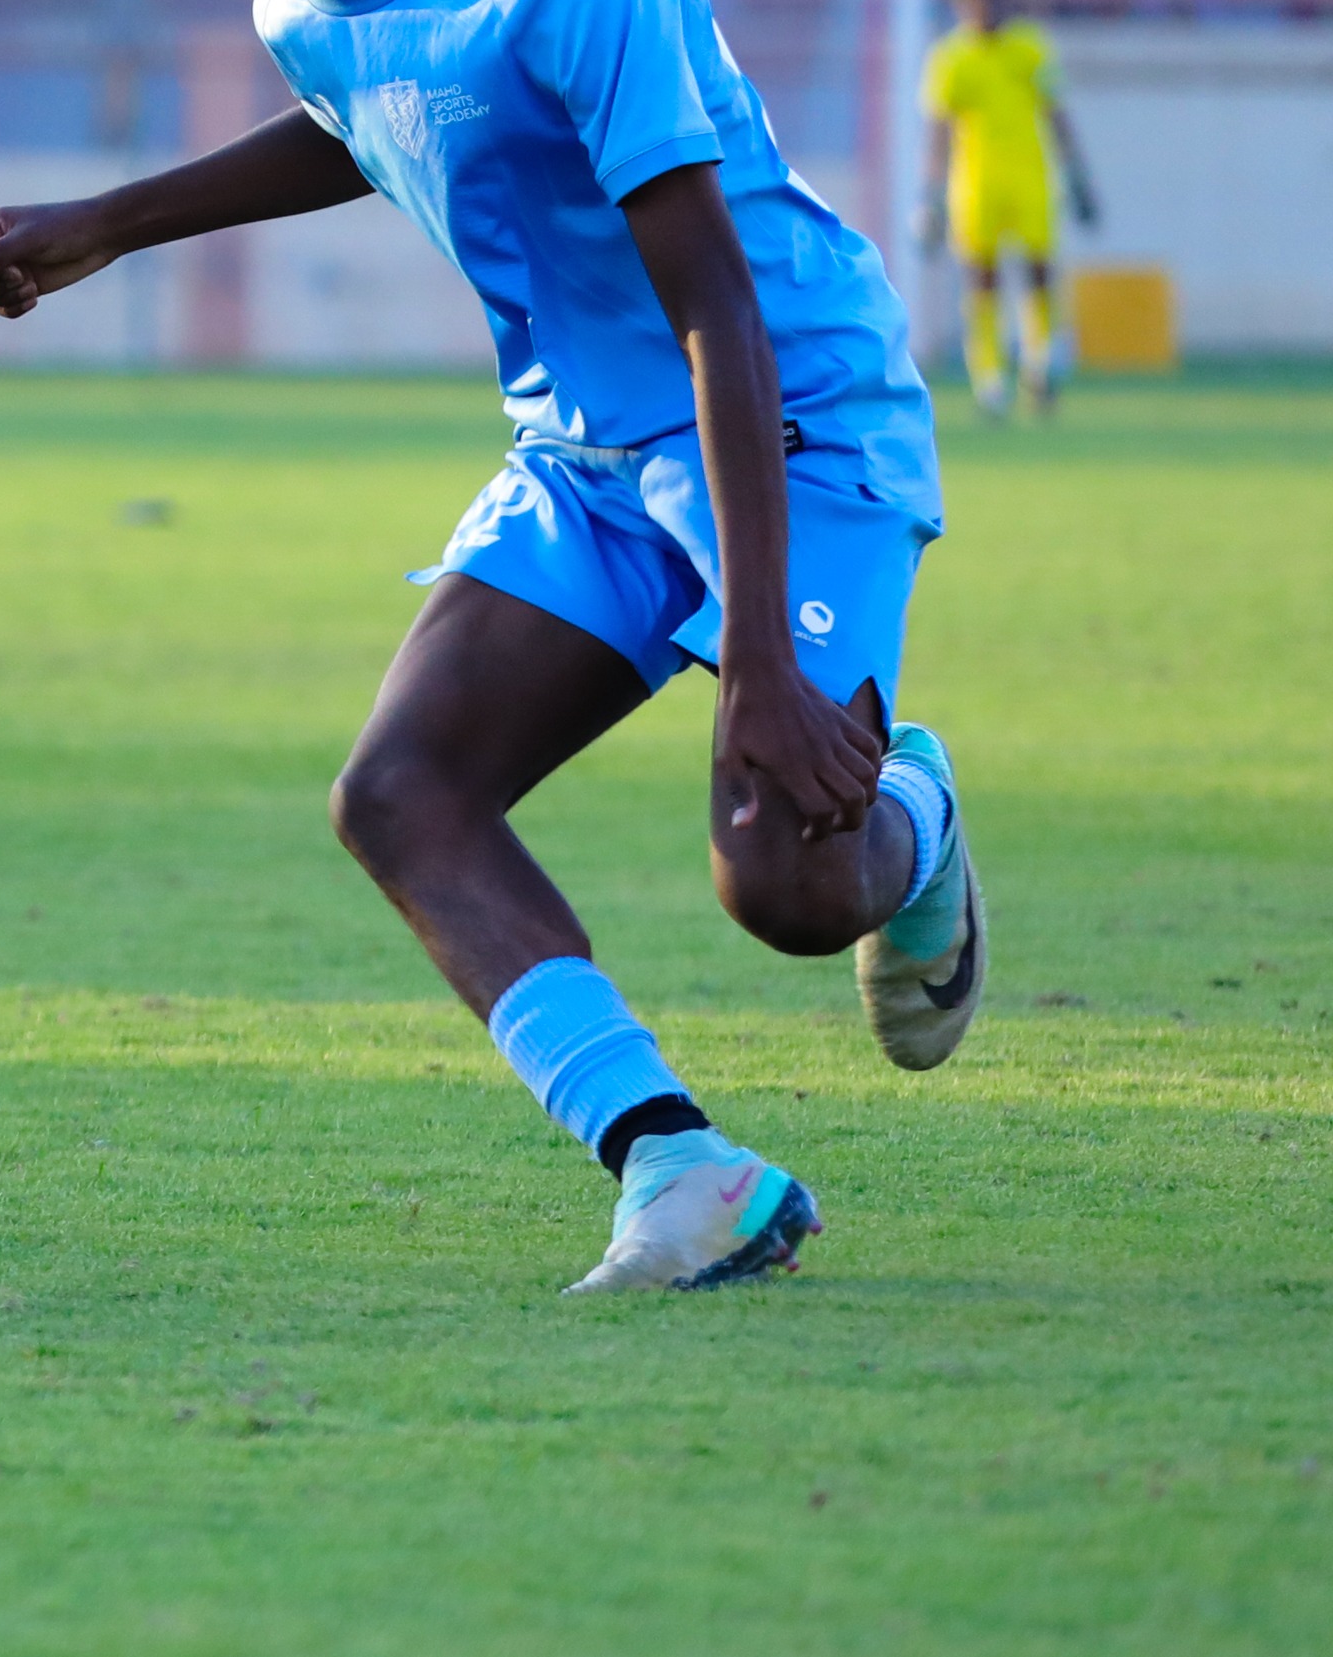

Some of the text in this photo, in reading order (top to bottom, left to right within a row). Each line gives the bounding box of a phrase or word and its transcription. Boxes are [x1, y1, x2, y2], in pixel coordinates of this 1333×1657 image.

[426, 83, 461, 100] MAHD
[429, 94, 475, 114] SPORTS
[433, 103, 490, 126] ACADEMY
